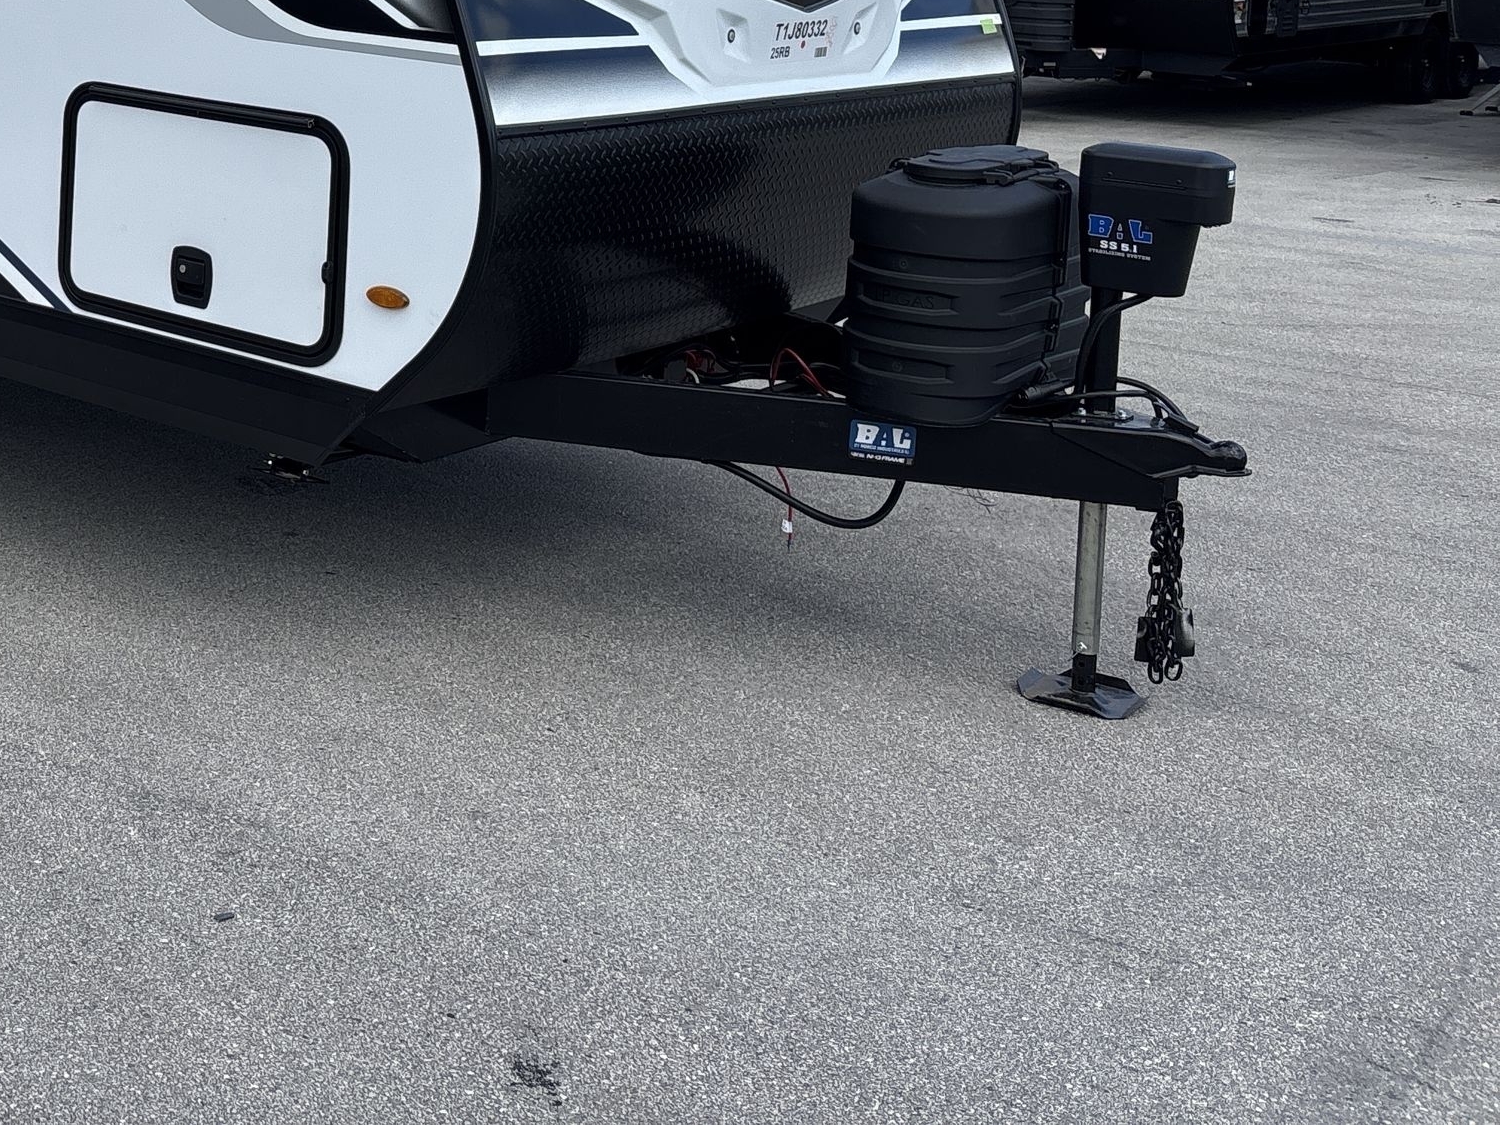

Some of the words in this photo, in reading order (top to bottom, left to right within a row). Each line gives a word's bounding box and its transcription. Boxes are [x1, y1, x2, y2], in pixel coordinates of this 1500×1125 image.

[776, 19, 828, 41] T1J80332
[770, 46, 790, 59] 25RB
[1088, 214, 1153, 244] BAL
[1100, 240, 1118, 250] SS
